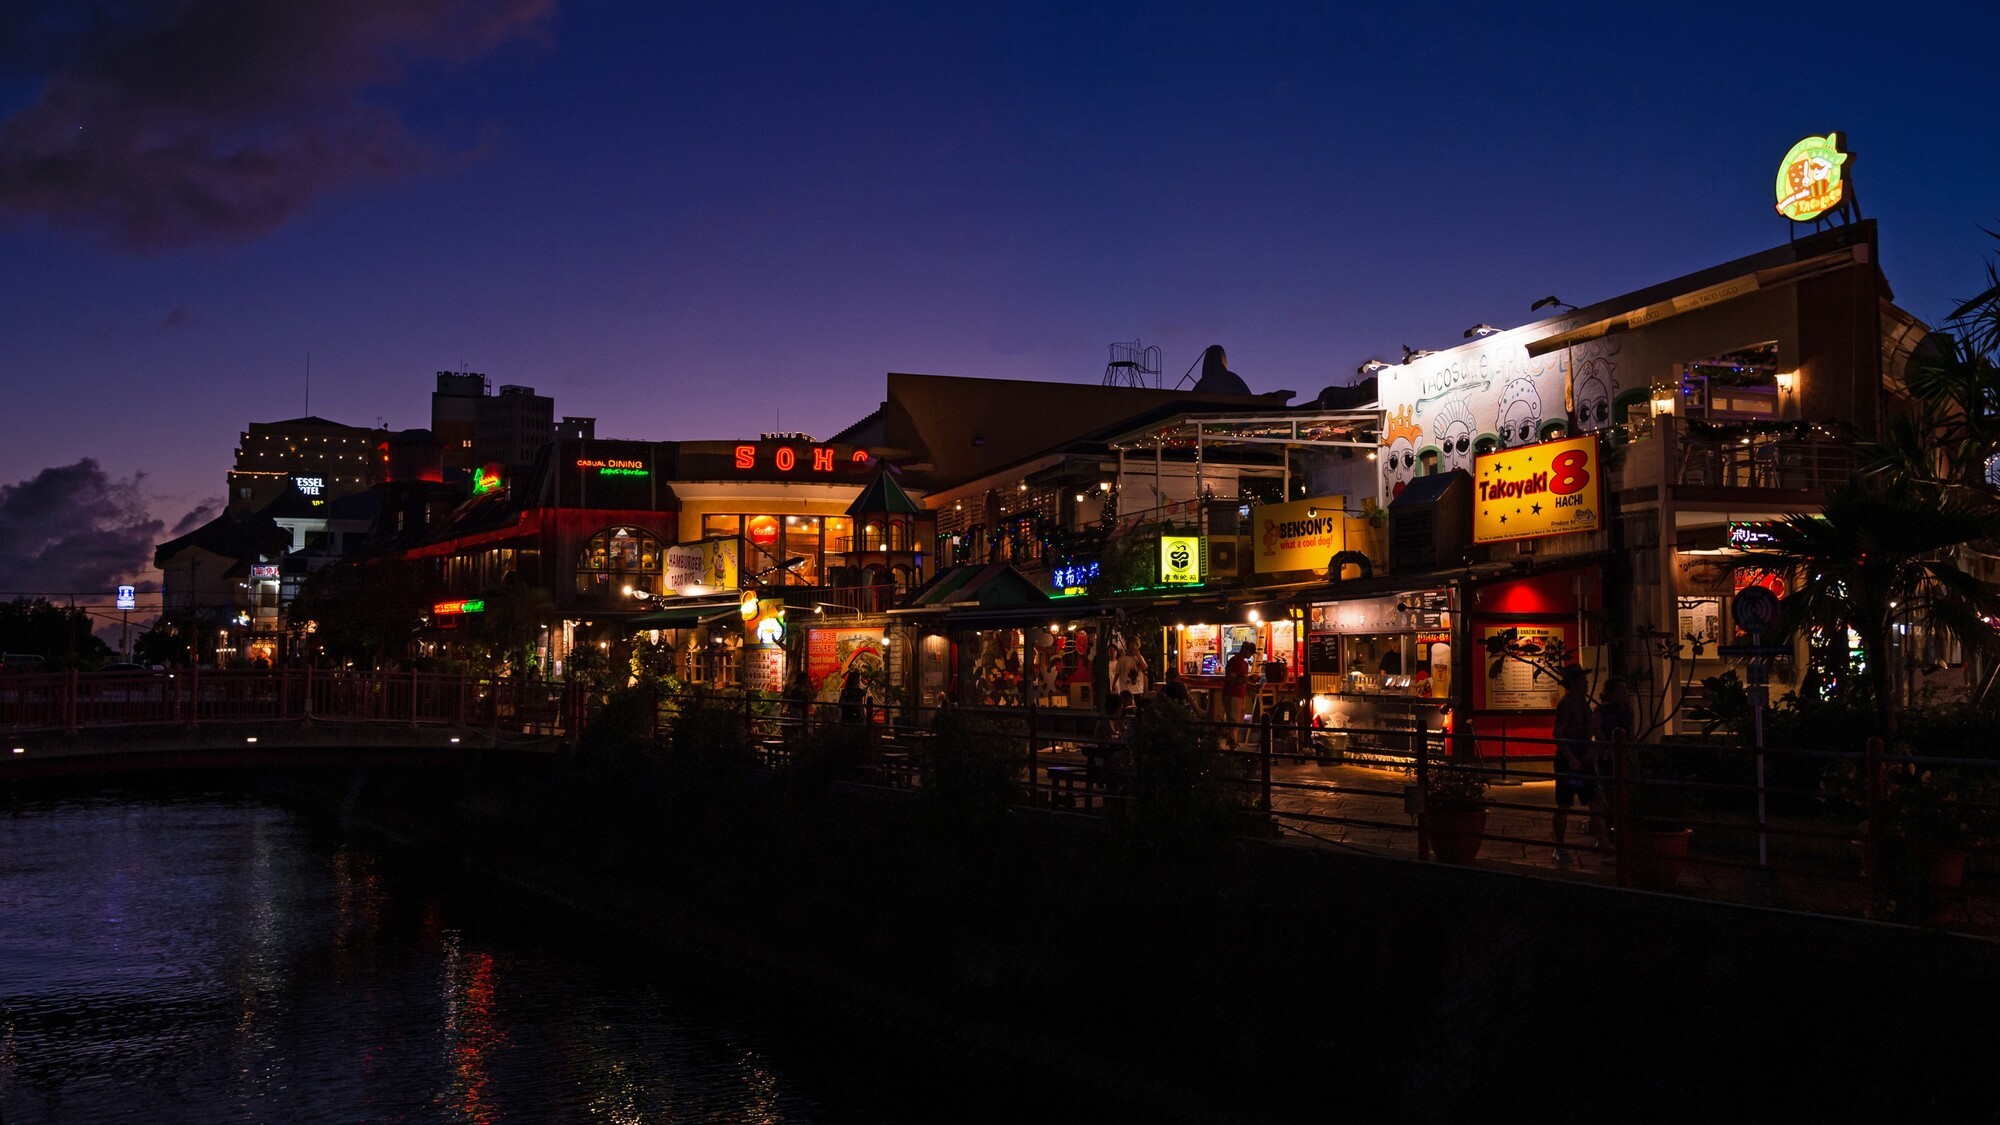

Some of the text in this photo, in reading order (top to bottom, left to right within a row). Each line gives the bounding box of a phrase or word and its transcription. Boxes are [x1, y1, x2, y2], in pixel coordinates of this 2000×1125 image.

[1799, 198, 1820, 213] TACO
[1700, 292, 1718, 305] TACO
[1719, 286, 1738, 299] LOCO
[608, 459, 643, 469] DINING
[1549, 449, 1591, 496] 8
[296, 477, 325, 488] ESSEL
[1479, 470, 1548, 503] Takoyaki
[299, 487, 320, 495] OTEL
[1555, 494, 1583, 508] HACHI
[1280, 517, 1333, 539] BENSON'S
[1280, 534, 1333, 550] what a cool dog!
[669, 553, 703, 572] HAMBURGER
[671, 574, 684, 587] TACO
